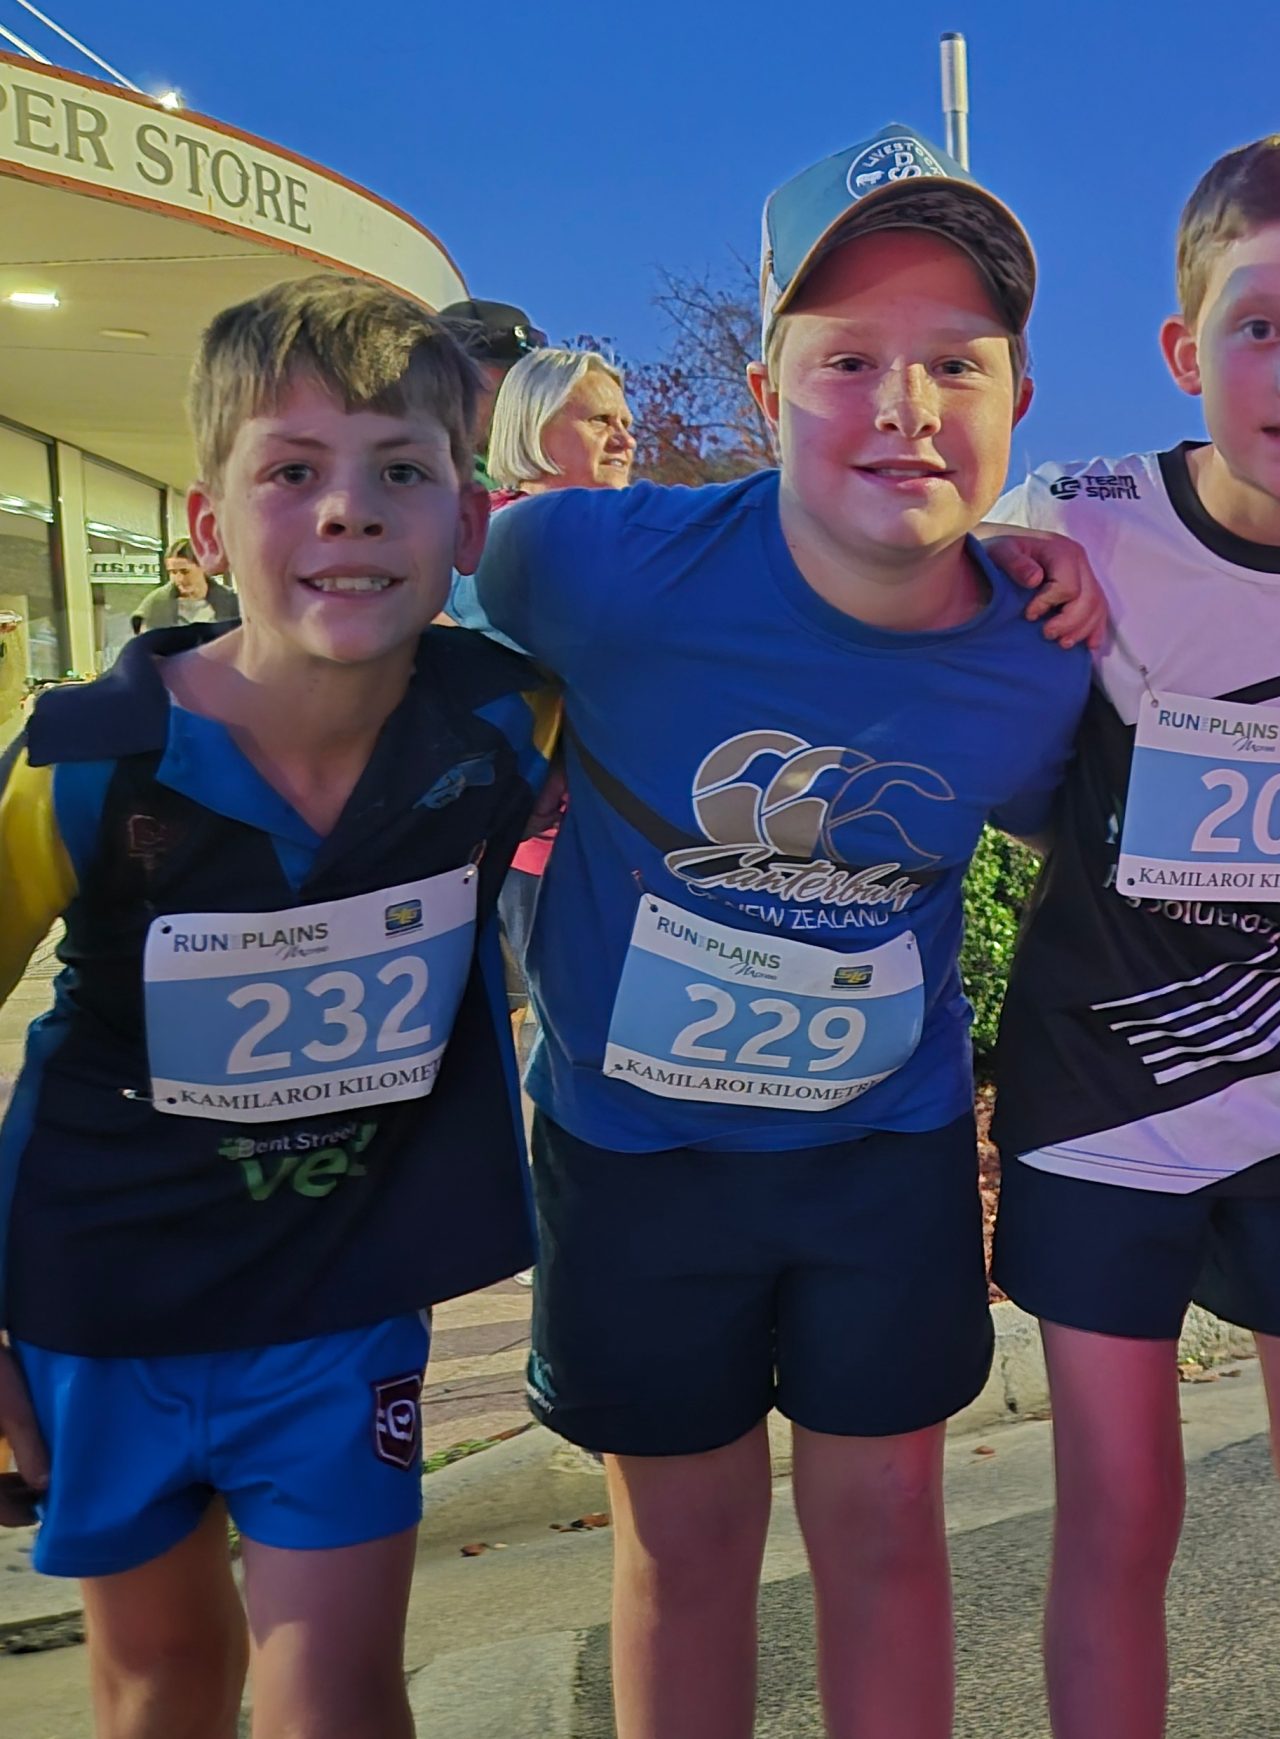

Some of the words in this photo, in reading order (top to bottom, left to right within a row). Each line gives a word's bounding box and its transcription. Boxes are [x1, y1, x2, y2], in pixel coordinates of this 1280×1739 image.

[0, 83, 114, 171] ER
[135, 123, 311, 234] STORE
[1085, 485, 1141, 501] spirit
[1158, 709, 1200, 732] RUN
[1208, 717, 1279, 740] PLAINS
[1138, 867, 1254, 888] KAMILAROI
[738, 903, 785, 928] EW
[789, 908, 889, 930] ZEALAND
[173, 934, 229, 953] RUN
[241, 923, 329, 950] PLAINS
[655, 915, 698, 946] RUN
[705, 937, 781, 970] PLAINS
[226, 955, 431, 1075] 232
[671, 983, 866, 1072] 229
[626, 1058, 753, 1094] KAMILAROI
[180, 1083, 331, 1110] KAMILAROI
